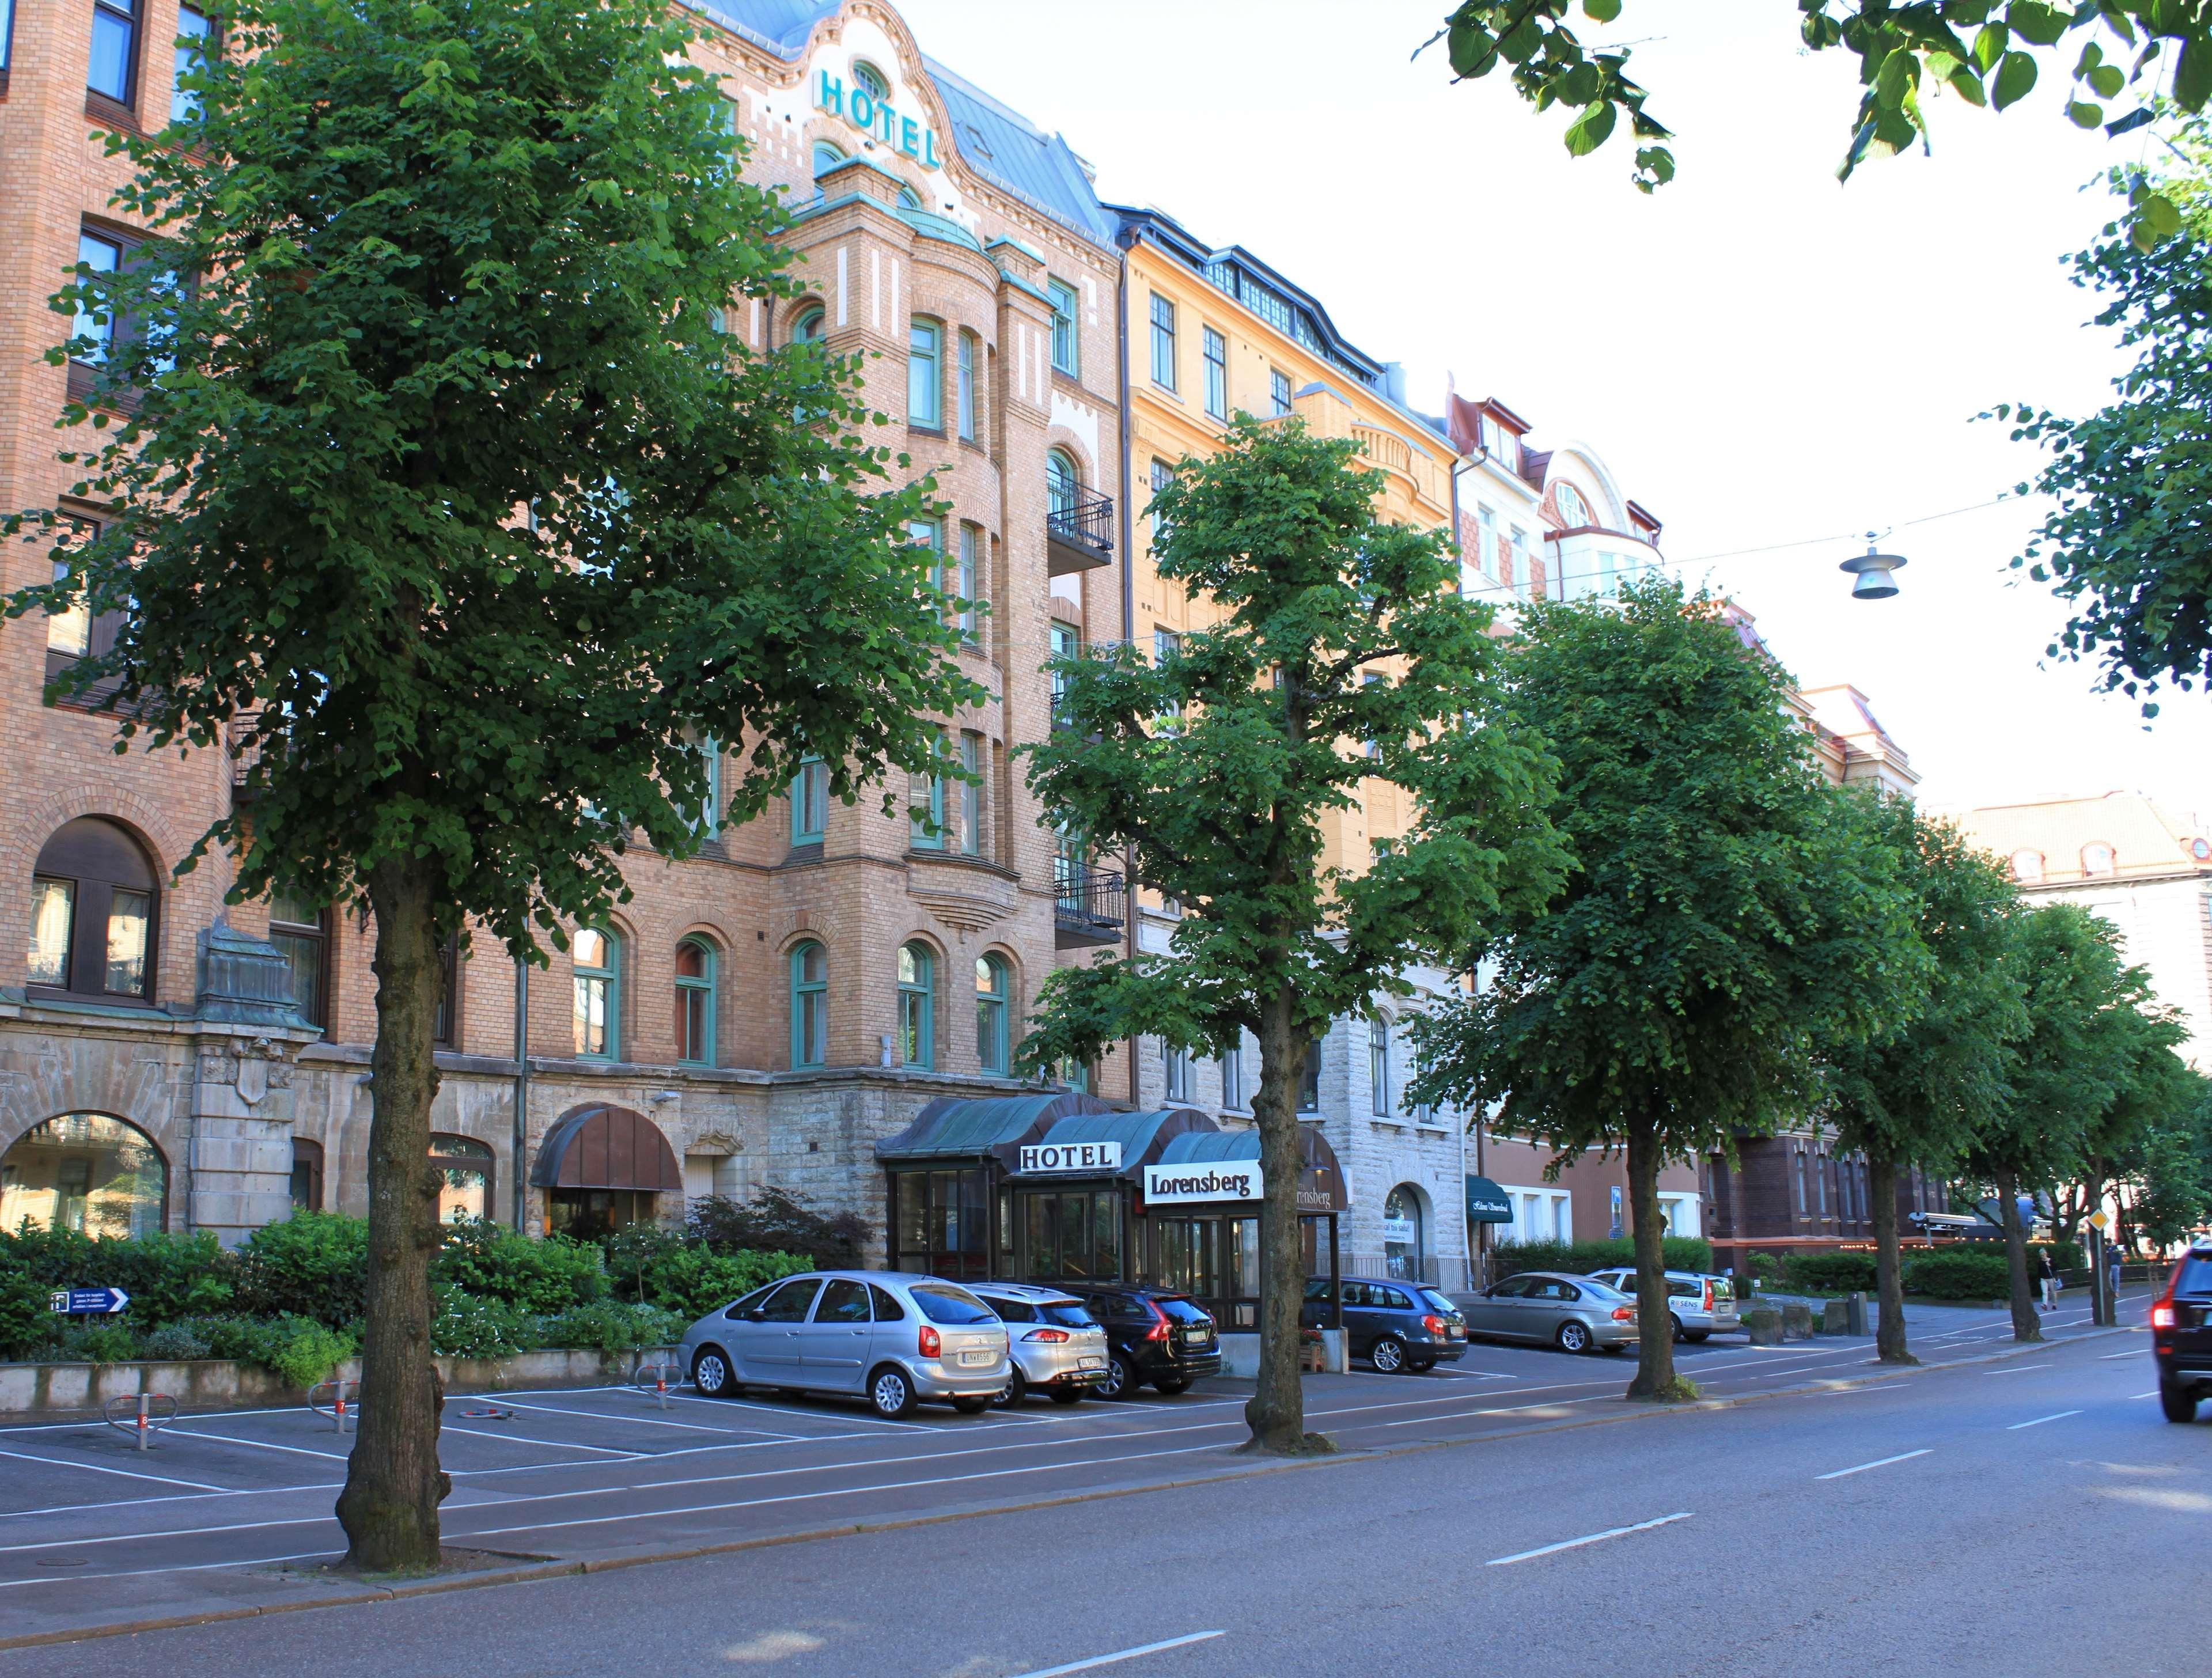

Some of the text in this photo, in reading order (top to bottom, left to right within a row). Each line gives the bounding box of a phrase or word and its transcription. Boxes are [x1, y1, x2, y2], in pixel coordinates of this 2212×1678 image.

[813, 69, 940, 172] HOTEL
[1021, 1145, 1112, 1168] HOTEL
[1151, 1170, 1251, 1197] Lorensberg
[1297, 1188, 1331, 1210] rensberg
[142, 1416, 147, 1424] 8
